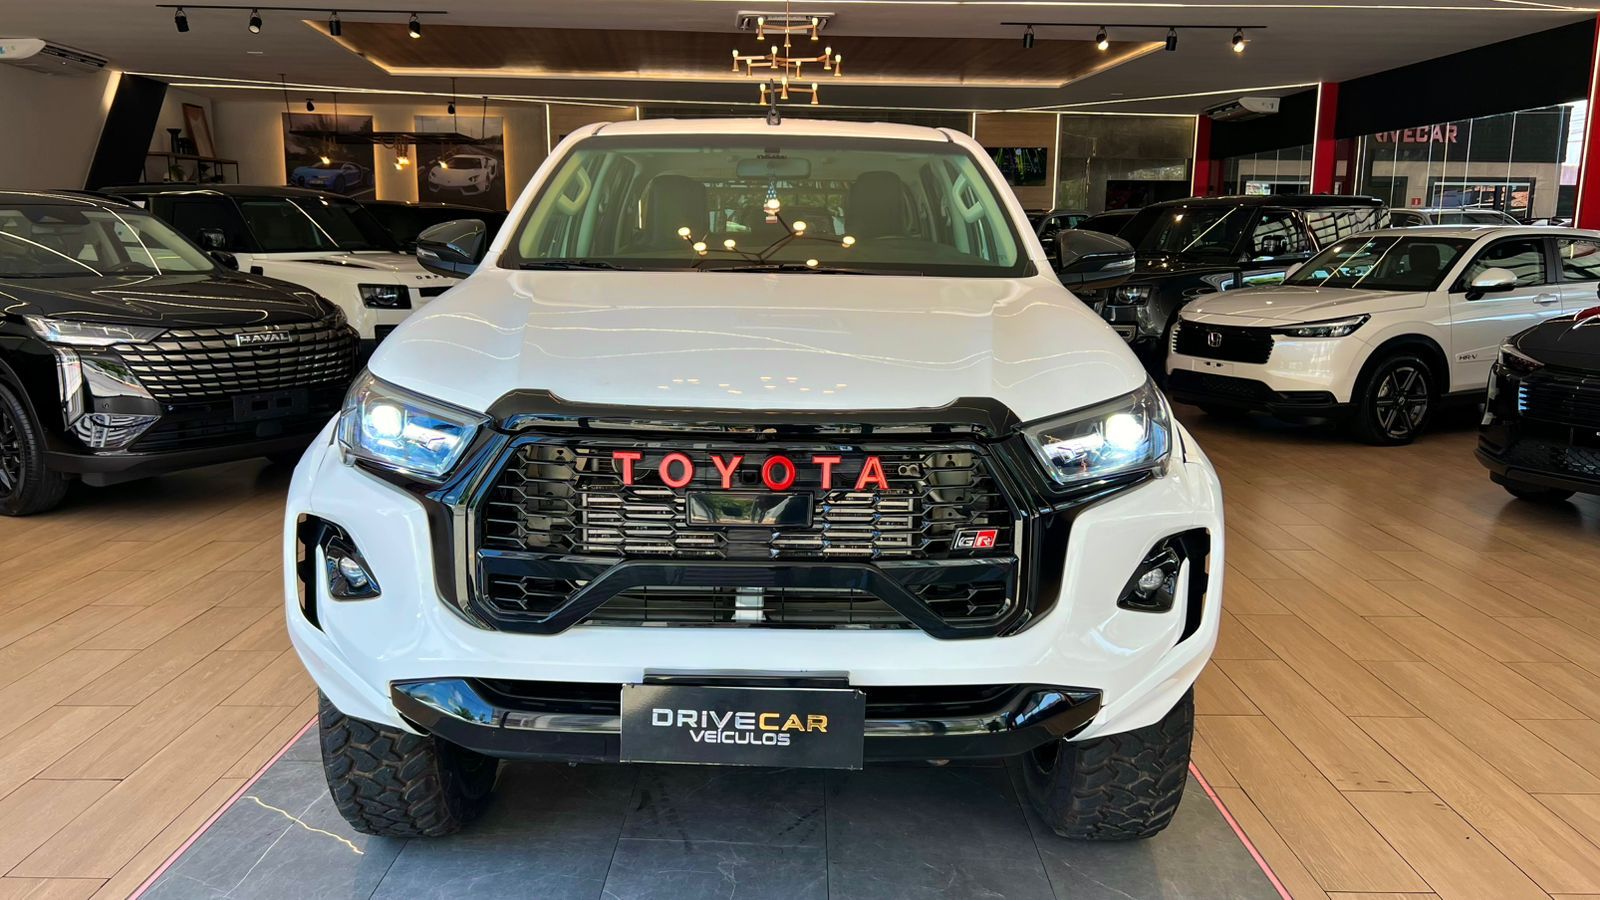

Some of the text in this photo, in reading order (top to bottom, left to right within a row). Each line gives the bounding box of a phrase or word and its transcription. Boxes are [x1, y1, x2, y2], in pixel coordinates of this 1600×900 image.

[240, 333, 289, 343] HAVAL
[612, 451, 889, 490] TOYOTA
[652, 708, 828, 732] DRIVECAR
[689, 728, 791, 746] VEÍCULOS
